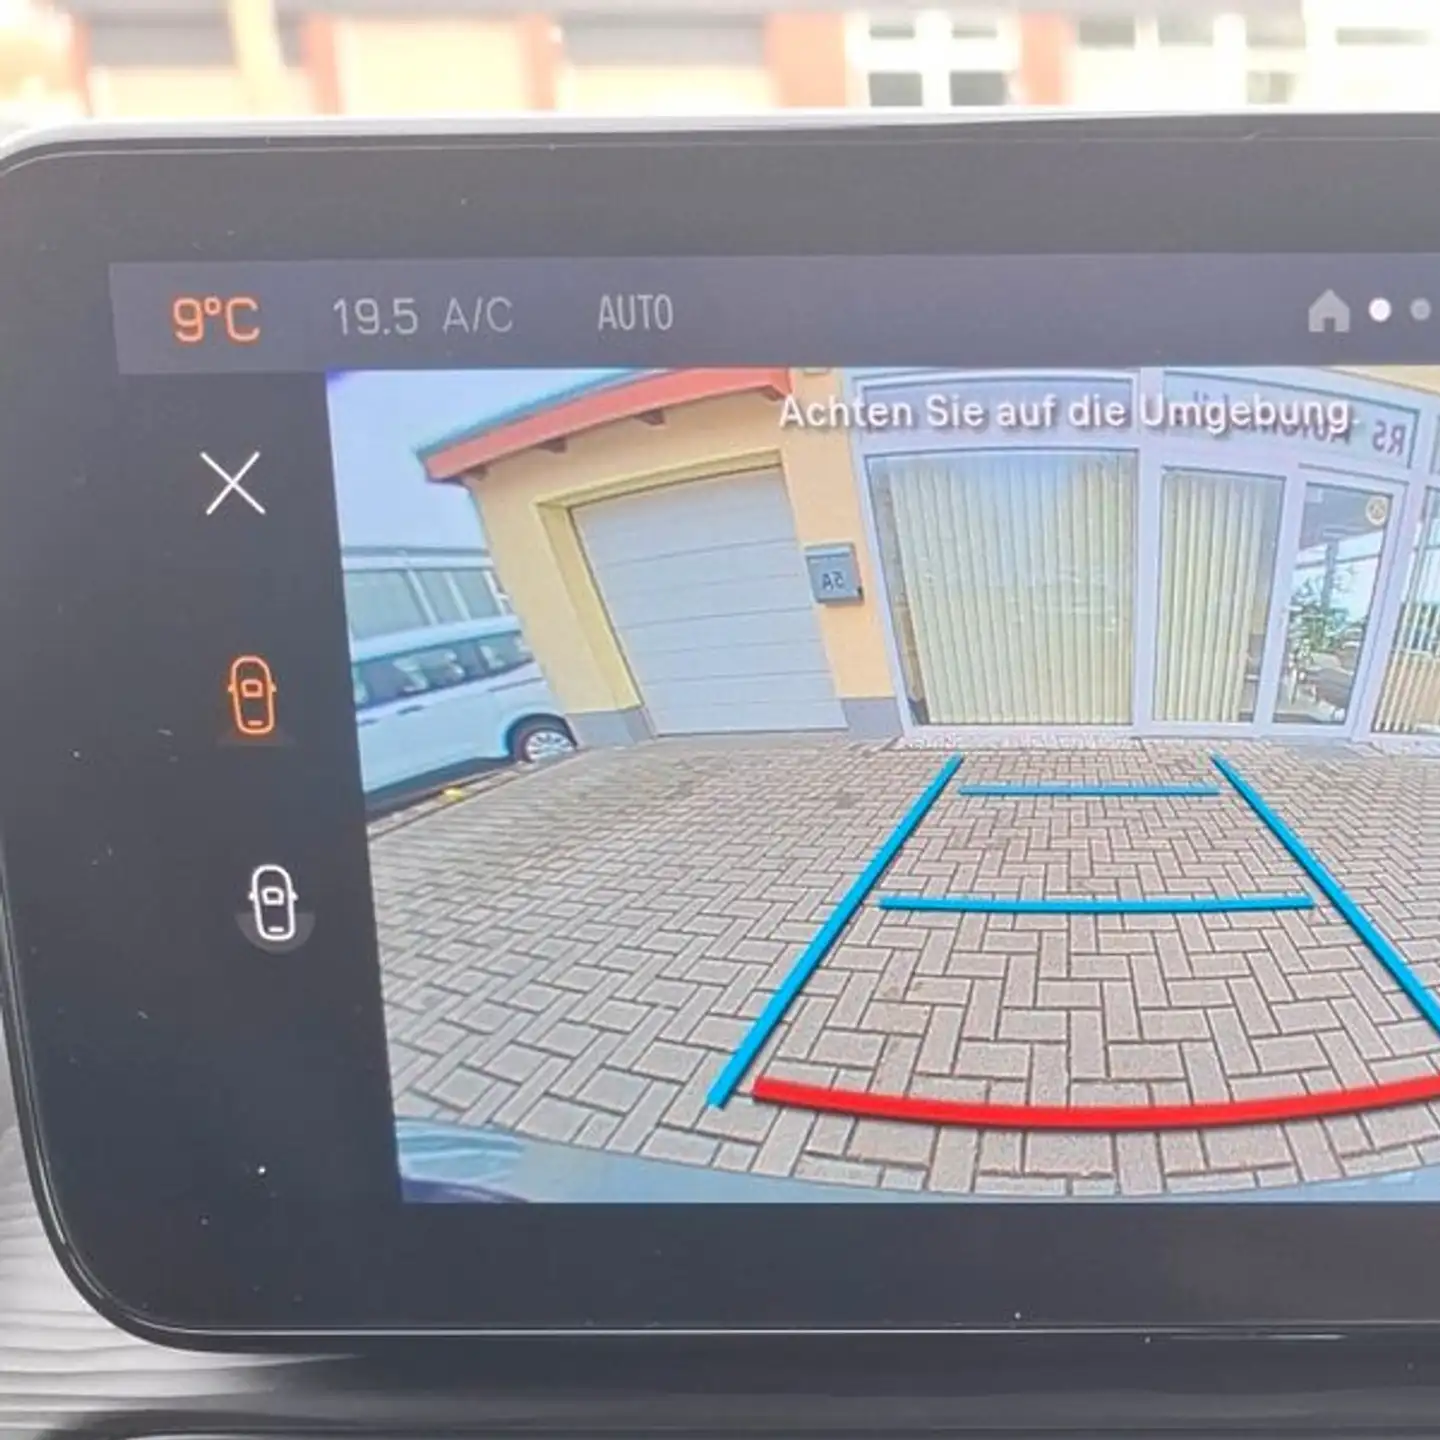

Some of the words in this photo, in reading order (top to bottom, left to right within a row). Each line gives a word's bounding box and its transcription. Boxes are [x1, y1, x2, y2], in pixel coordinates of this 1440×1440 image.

[172, 297, 262, 343] 9°C
[332, 298, 419, 336] 19.5
[442, 297, 513, 334] A/C
[598, 293, 673, 332] AUTO
[780, 395, 912, 428] Achten
[926, 393, 984, 428] Sie
[997, 394, 1056, 428] auf
[1068, 394, 1126, 428] die
[1140, 391, 1350, 435] Umgebung
